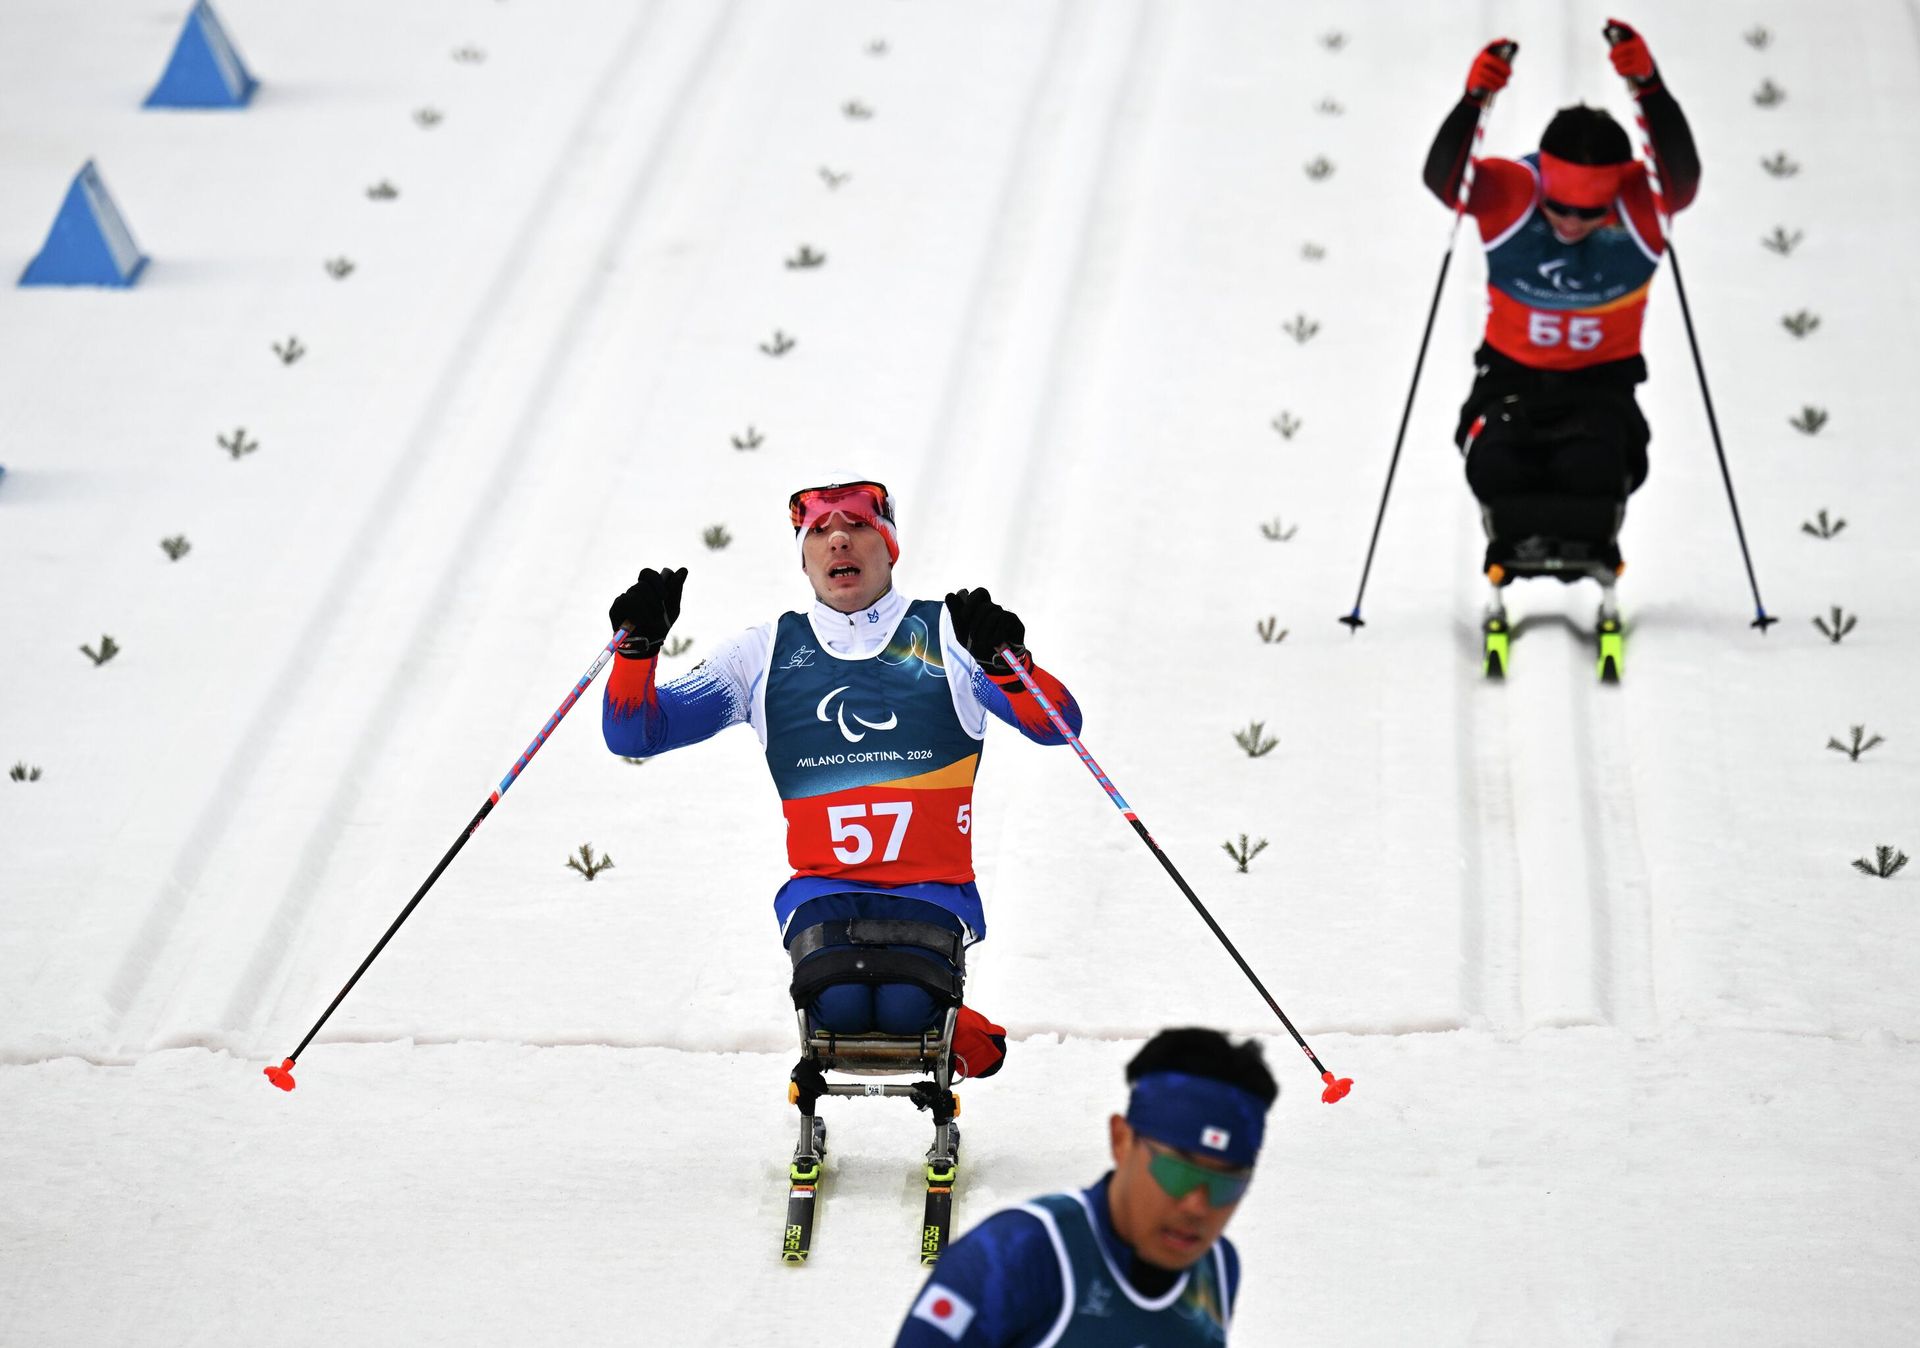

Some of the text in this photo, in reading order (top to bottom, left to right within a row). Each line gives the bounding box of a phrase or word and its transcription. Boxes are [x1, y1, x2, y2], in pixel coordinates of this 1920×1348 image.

[1529, 311, 1603, 350] 55
[797, 749, 933, 768] MILANO CORTINA 2026
[827, 801, 913, 865] 57
